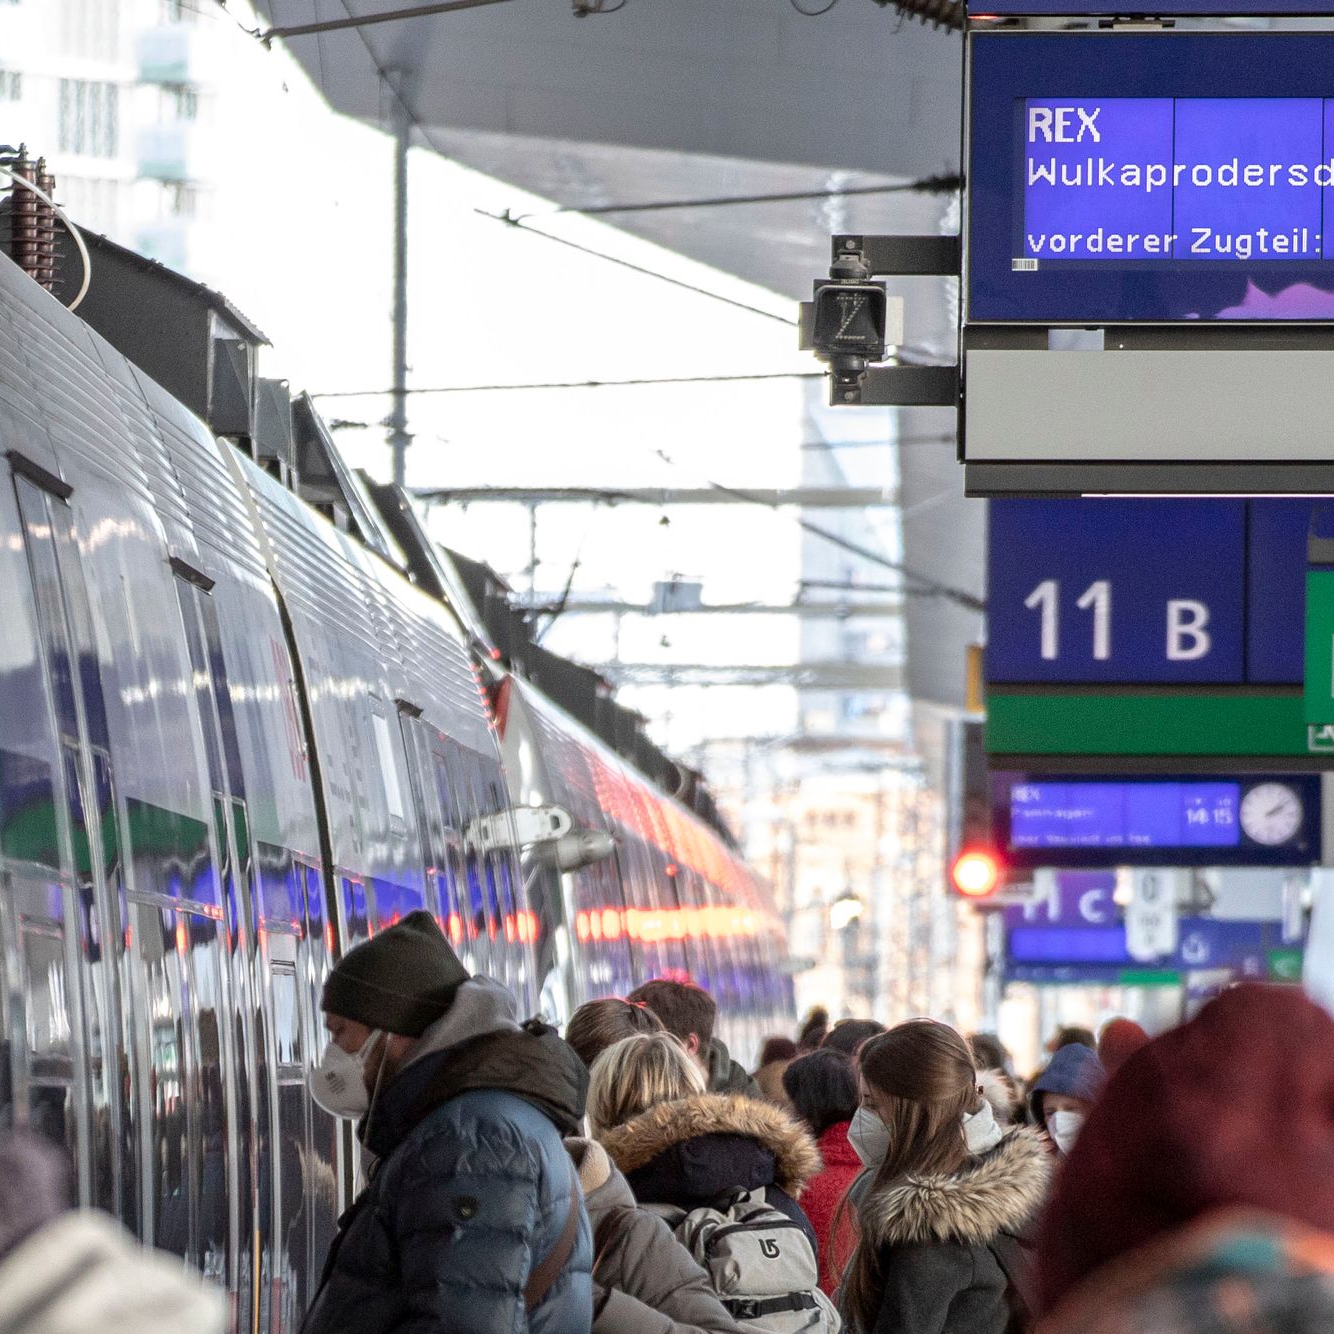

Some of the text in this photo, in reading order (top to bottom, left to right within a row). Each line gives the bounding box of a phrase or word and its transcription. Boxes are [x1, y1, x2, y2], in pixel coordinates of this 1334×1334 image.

[1028, 107, 1101, 143] REX
[1028, 228, 1322, 259] vorderer Zugteil:
[1024, 579, 1211, 660] 11 B
